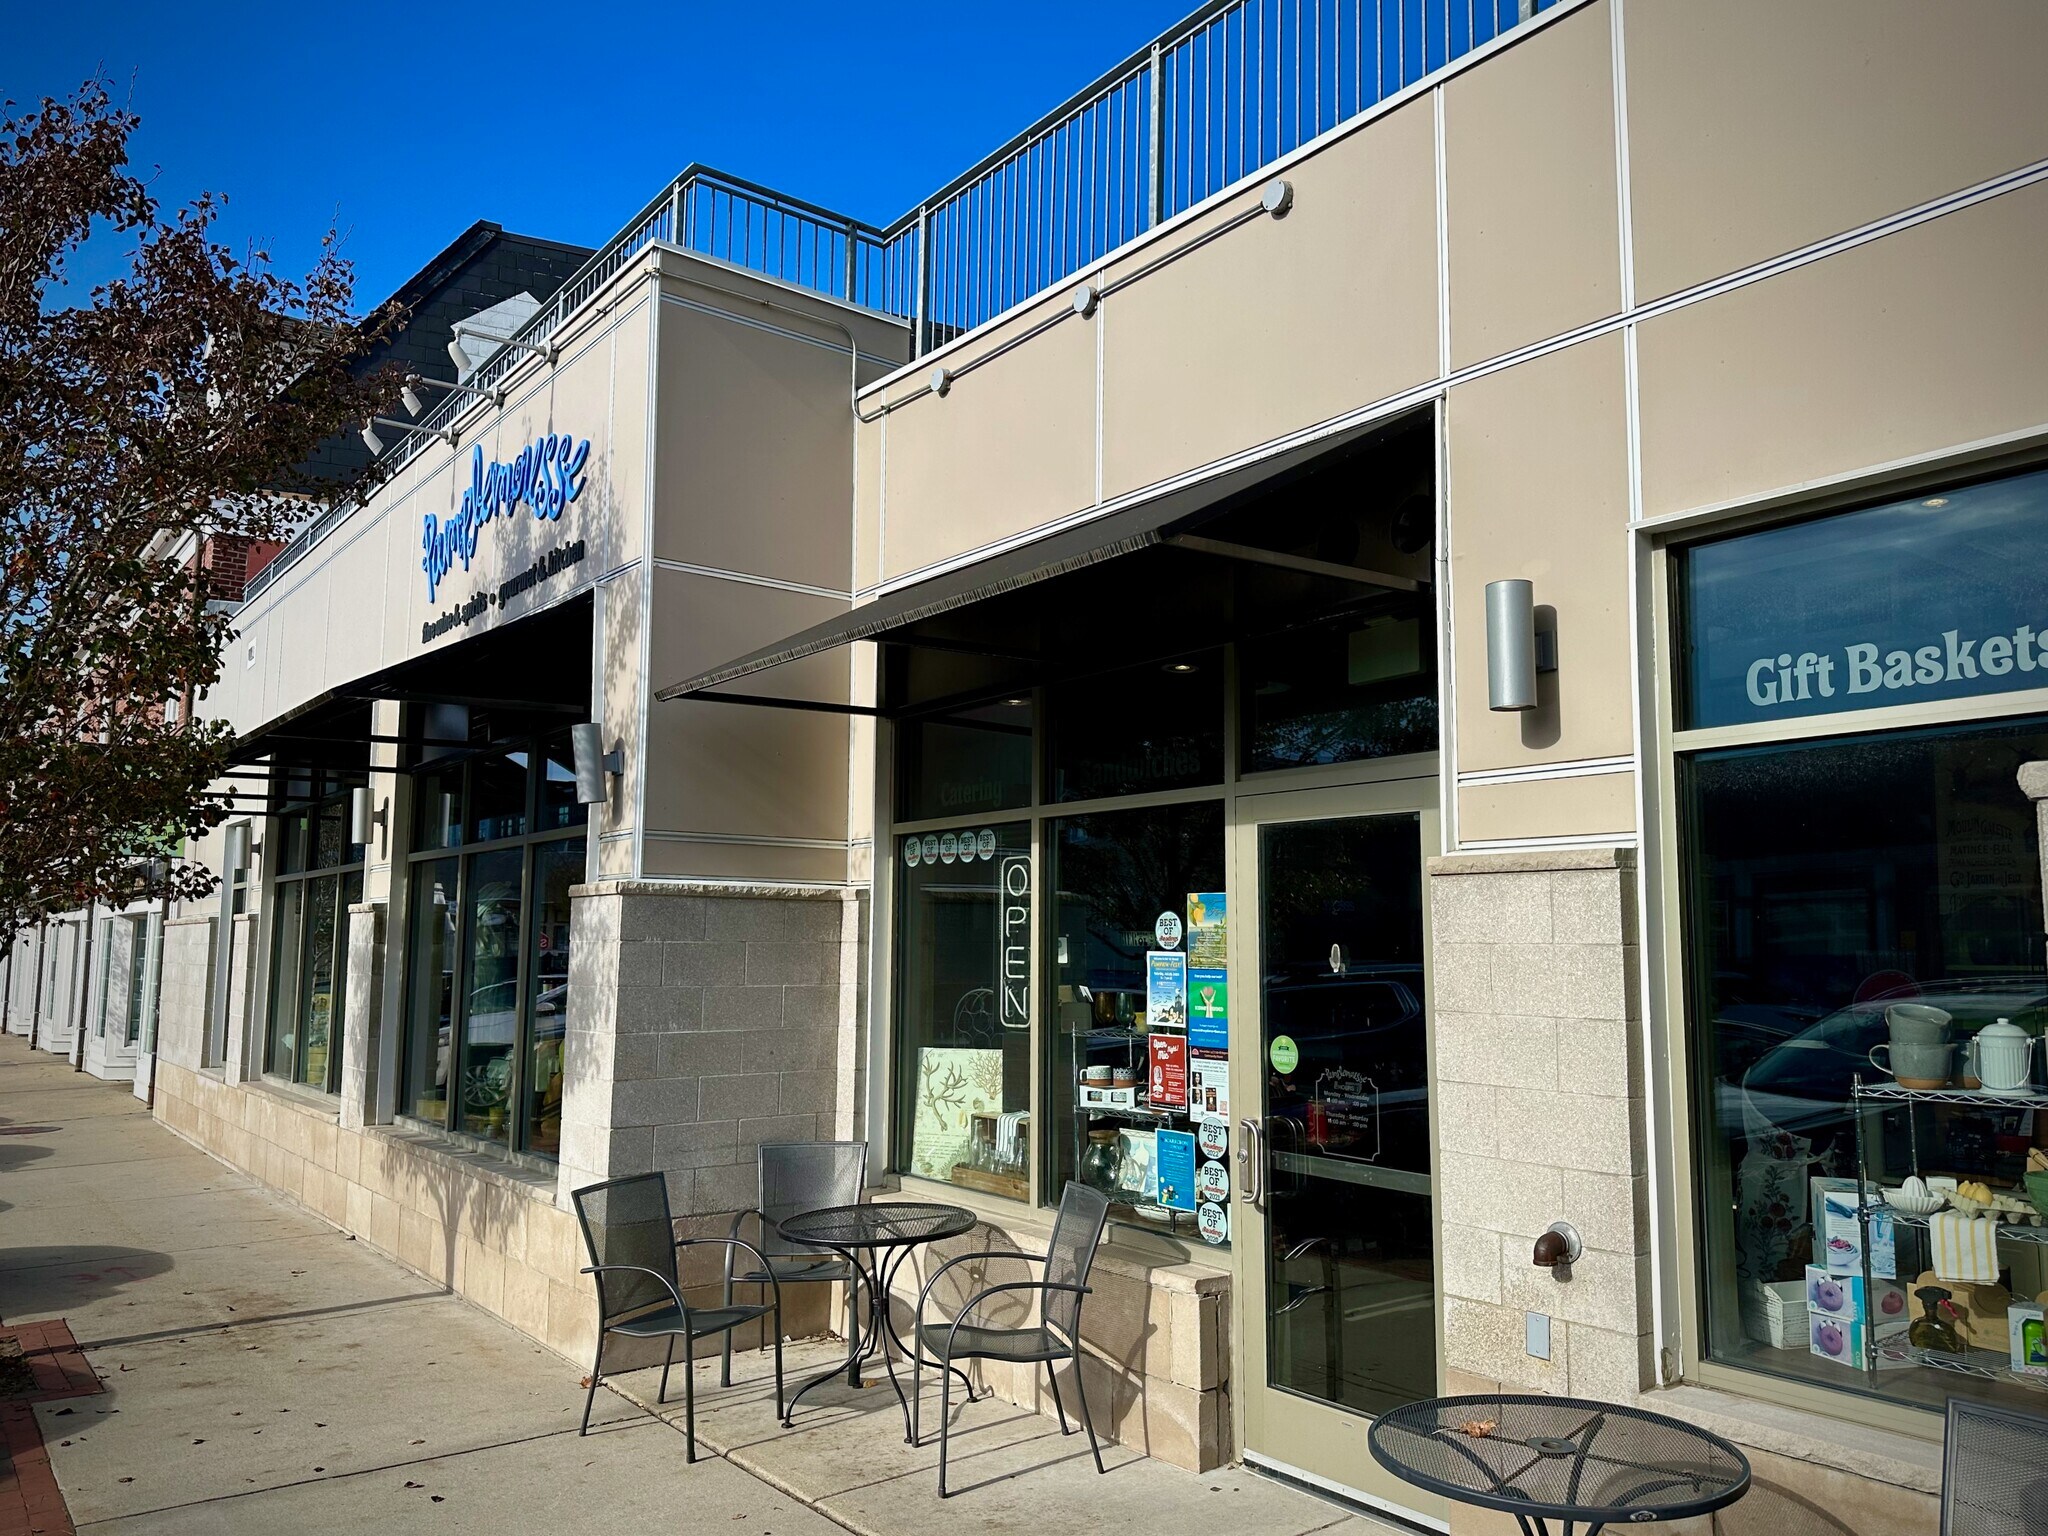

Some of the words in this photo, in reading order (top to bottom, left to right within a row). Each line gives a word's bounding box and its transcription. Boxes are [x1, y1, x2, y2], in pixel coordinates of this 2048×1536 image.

[436, 611, 453, 636] wine
[453, 603, 461, 627] &
[461, 591, 488, 626] spirits
[498, 562, 537, 610] gourmet
[537, 555, 548, 582] &
[548, 540, 584, 577] kitchen
[1746, 652, 1835, 706] Gift
[941, 776, 1002, 807] Catering
[942, 838, 955, 846] BEST
[961, 836, 974, 844] BEST
[906, 842, 918, 850] BEST
[1160, 918, 1178, 926] BEST
[1164, 927, 1174, 935] OF
[1005, 864, 1028, 1019] OPEN
[1324, 1090, 1340, 1098] Monday
[1326, 1111, 1345, 1120] Thursday
[1349, 1114, 1368, 1122] Saturday
[1203, 1123, 1222, 1136] BEST
[1207, 1134, 1218, 1144] OF
[1204, 1166, 1224, 1178] BEST
[1208, 1176, 1220, 1186] OF
[1202, 1208, 1222, 1220] BEST
[1206, 1218, 1218, 1228] OF
